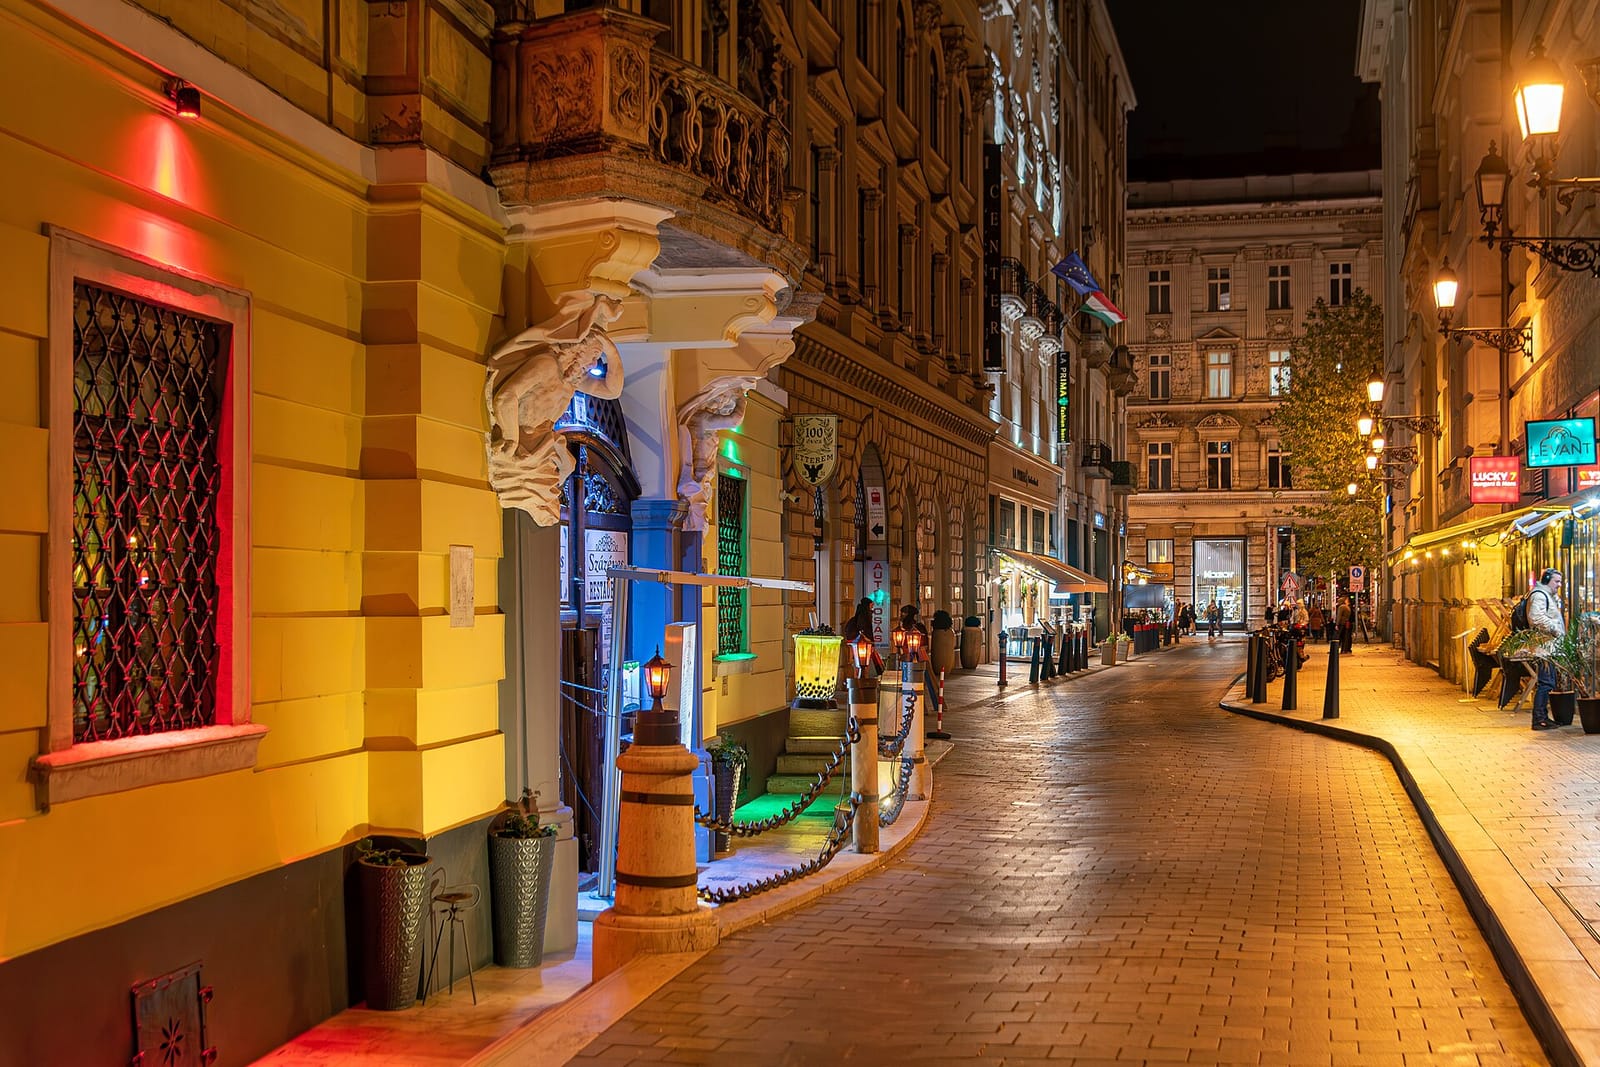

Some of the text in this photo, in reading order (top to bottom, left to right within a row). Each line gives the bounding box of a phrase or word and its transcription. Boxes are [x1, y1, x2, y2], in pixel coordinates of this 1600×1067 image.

[990, 184, 999, 334] CENTER
[1060, 352, 1068, 397] LA PRIMA
[806, 427, 823, 438] 100
[1530, 442, 1592, 457] LEVANT
[1472, 471, 1517, 481] LUCKY 7
